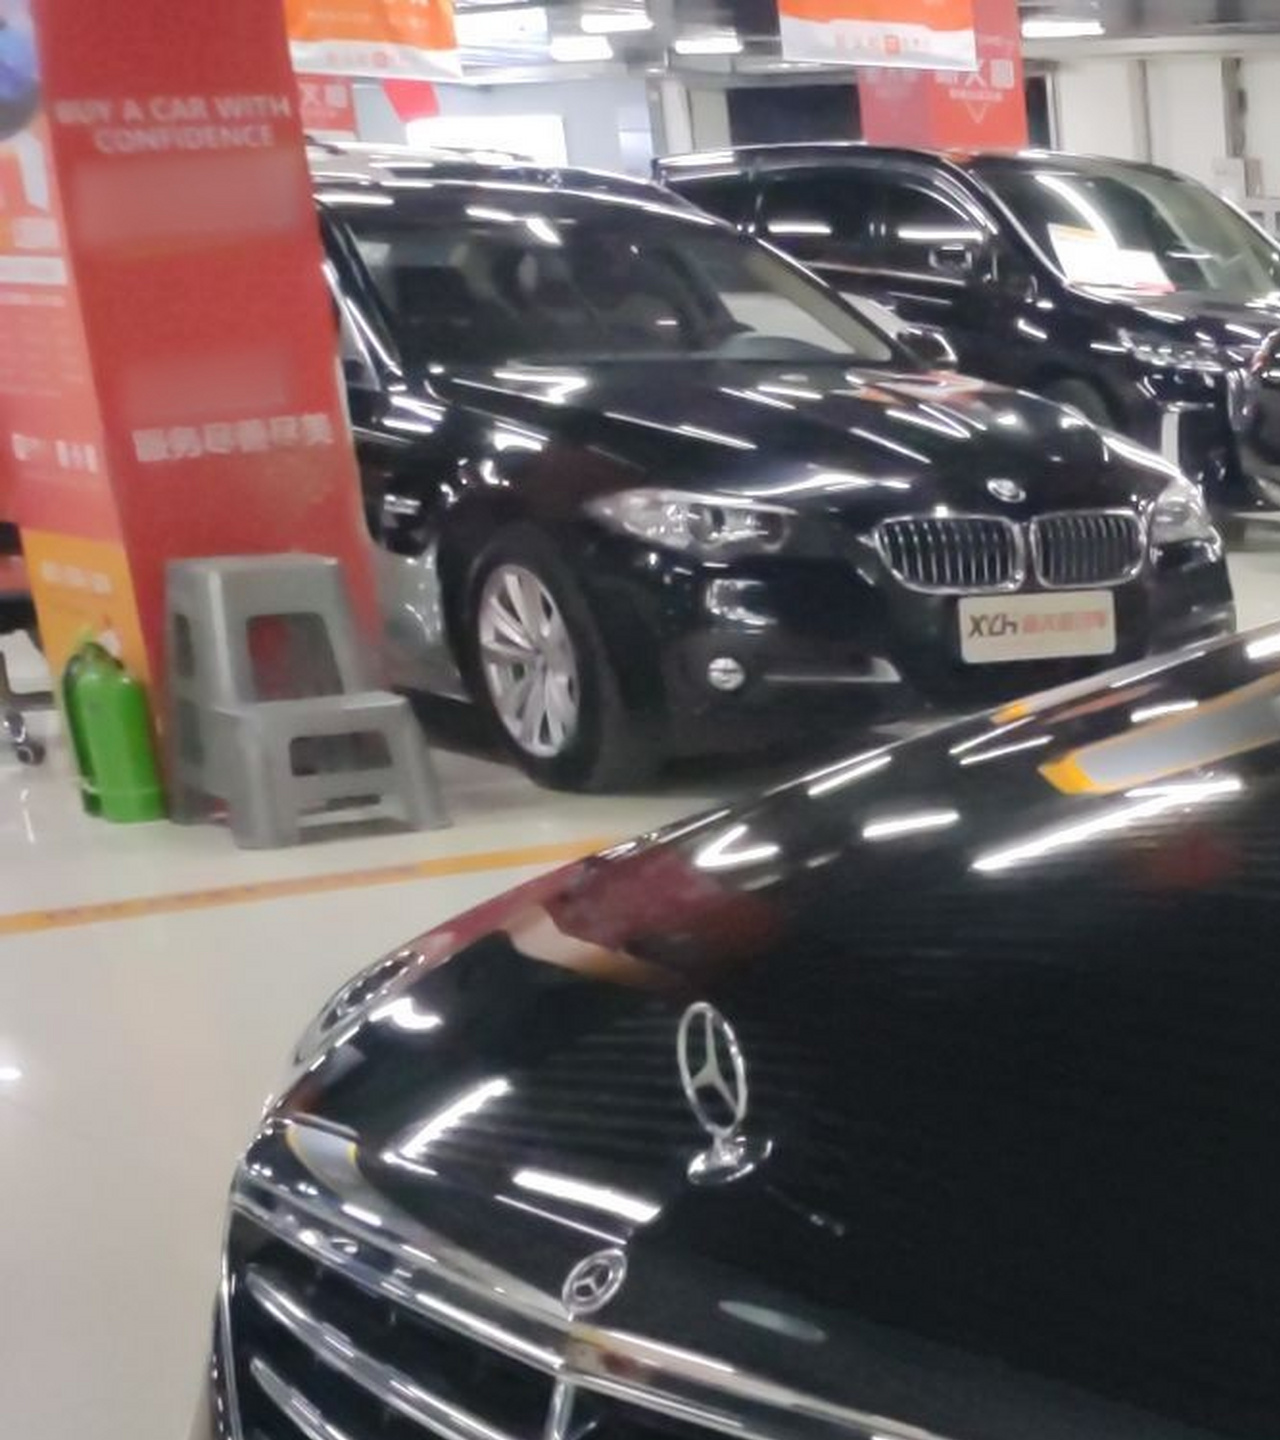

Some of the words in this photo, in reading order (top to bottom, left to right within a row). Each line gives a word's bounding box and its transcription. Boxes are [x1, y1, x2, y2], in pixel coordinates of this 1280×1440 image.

[121, 97, 144, 122] A
[149, 95, 209, 121] CAR
[212, 93, 292, 120] WITH
[94, 122, 274, 153] CONFIDENCE
